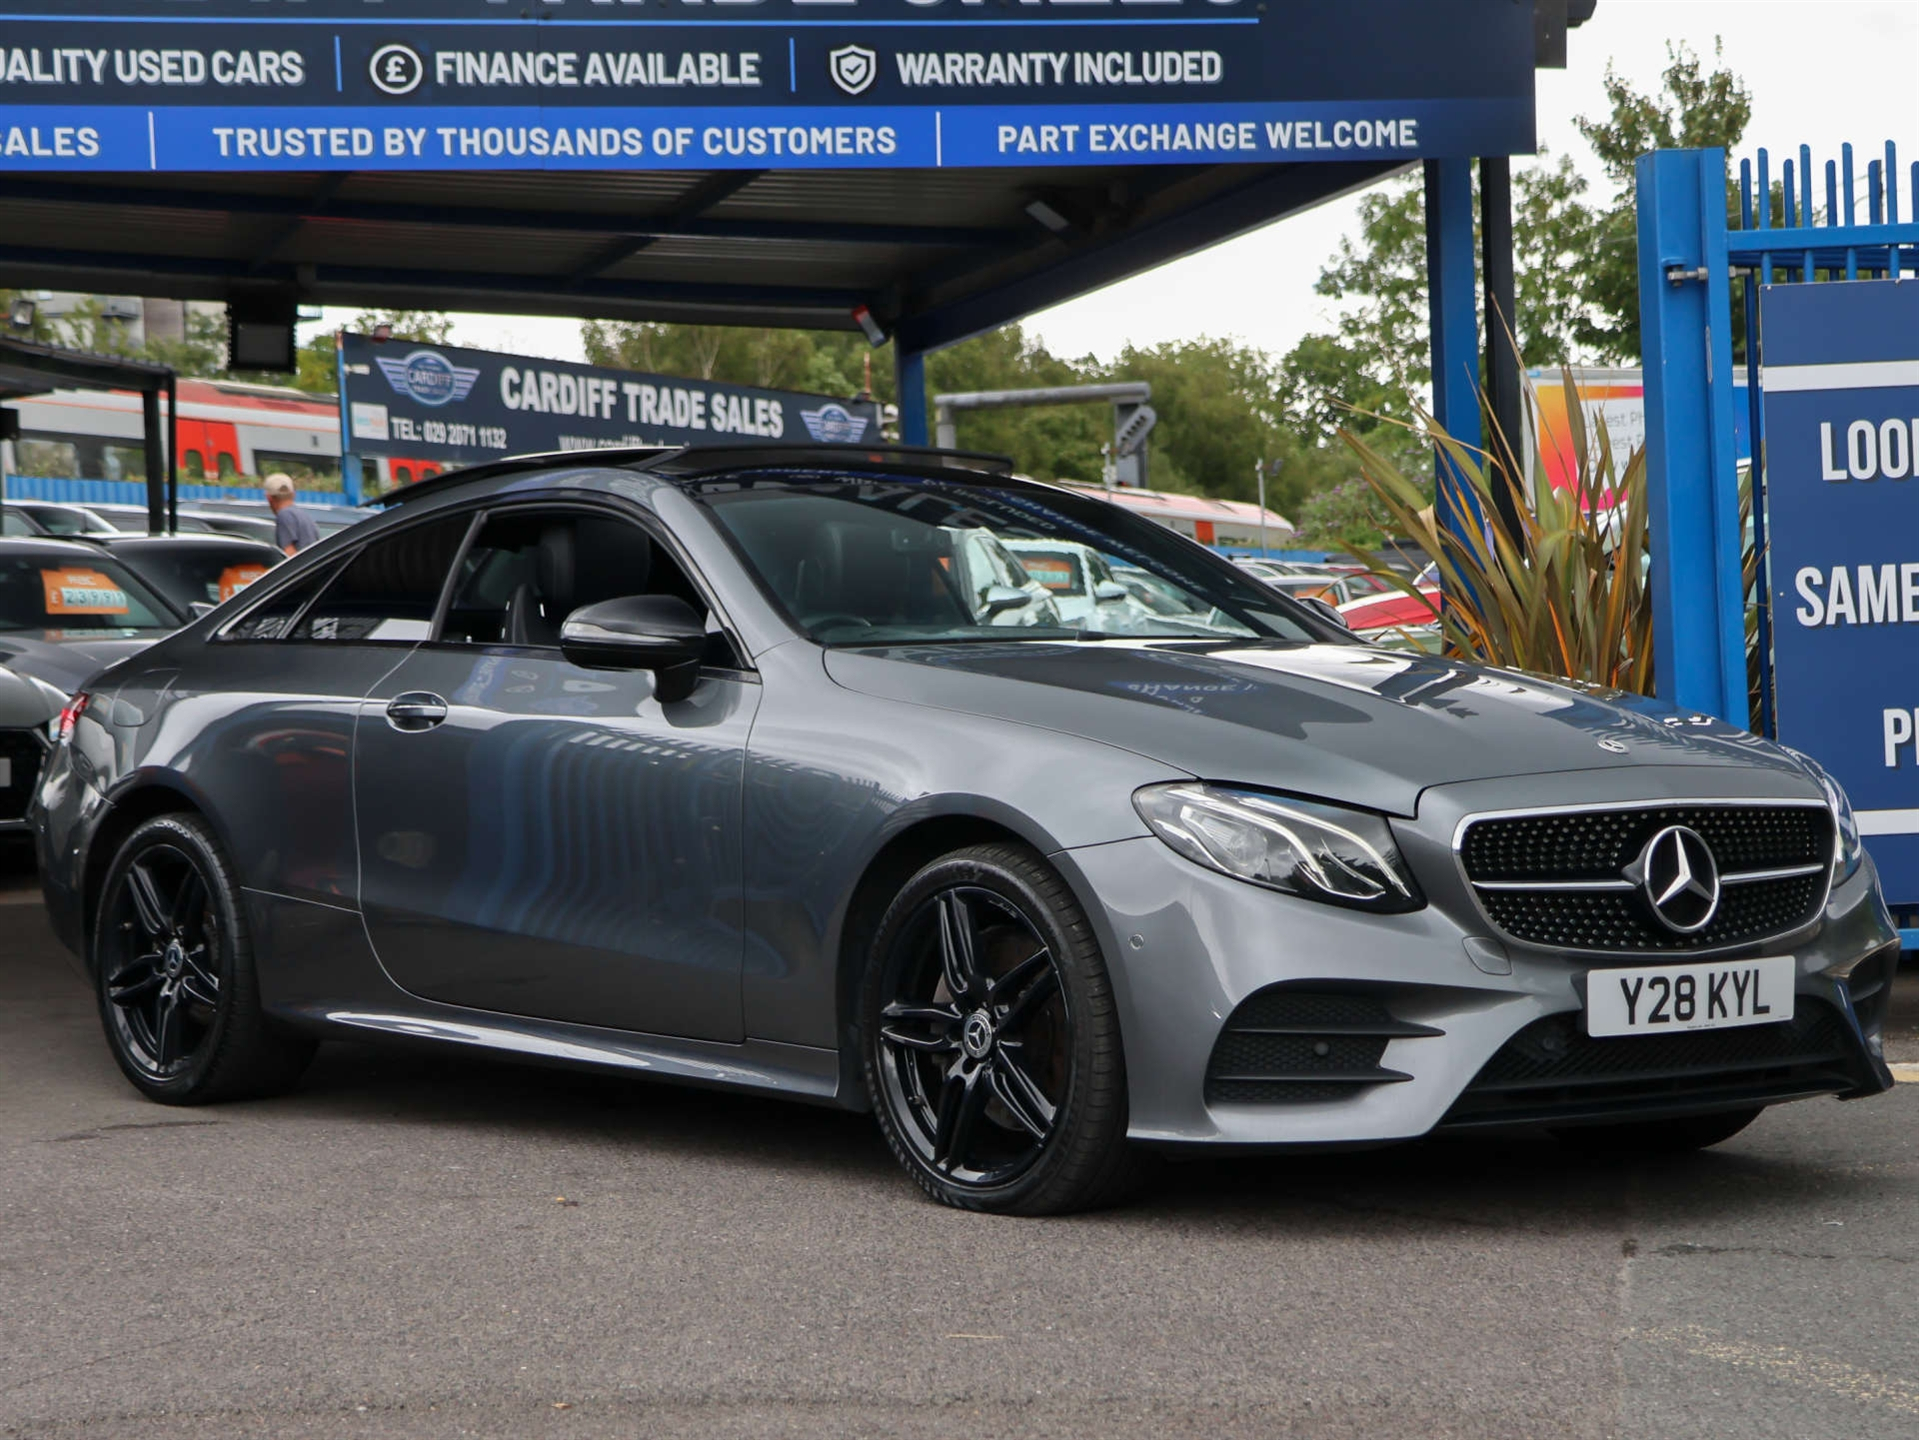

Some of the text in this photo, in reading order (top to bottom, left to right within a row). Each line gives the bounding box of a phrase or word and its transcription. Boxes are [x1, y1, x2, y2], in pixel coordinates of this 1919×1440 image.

[0, 48, 305, 84] ALITY USED CARS
[436, 52, 762, 86] FINANCE AVAILABLE
[896, 51, 1223, 85] WARRANTY INCLUDED
[0, 127, 100, 157] ALES
[213, 127, 896, 157] TRUSTED BY THOUSANDS OF CUSTOMERS
[999, 120, 1418, 153] PART EXCHANGE WELCOME
[500, 366, 617, 419] CARDIFF
[622, 382, 707, 430] TRADE
[710, 392, 784, 438] SALES
[390, 416, 422, 441] TEL:
[424, 420, 447, 444] 029
[447, 424, 477, 447] 2071
[478, 427, 507, 449] 1132
[1794, 562, 1919, 628] SAME
[1882, 708, 1919, 768] P
[1620, 967, 1771, 1026] Y28 KYL
